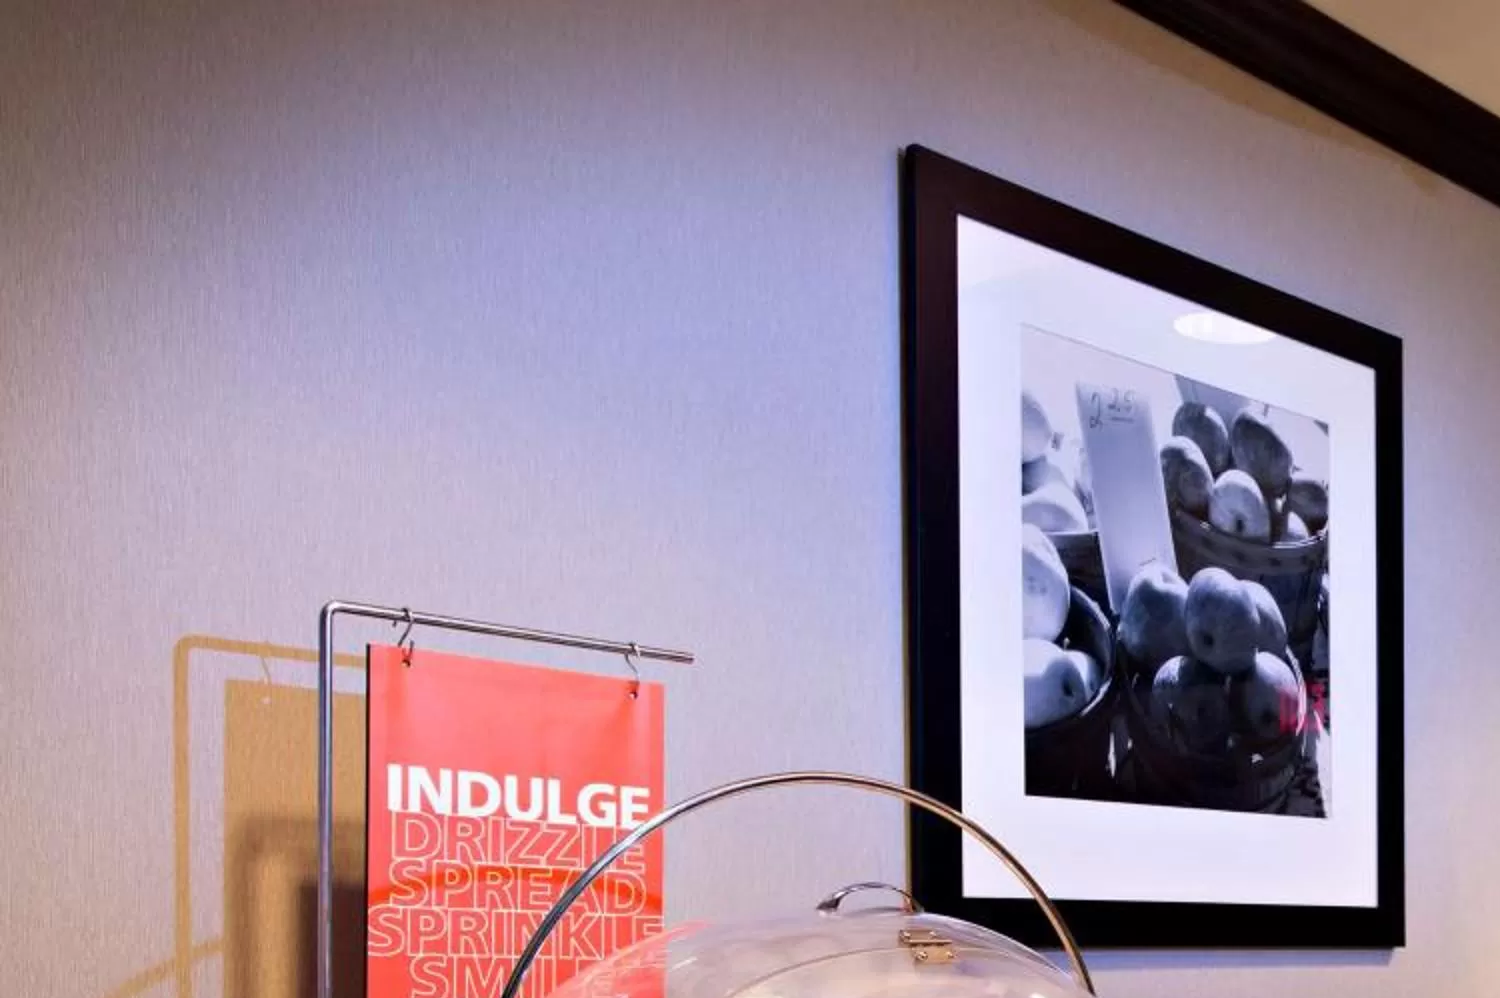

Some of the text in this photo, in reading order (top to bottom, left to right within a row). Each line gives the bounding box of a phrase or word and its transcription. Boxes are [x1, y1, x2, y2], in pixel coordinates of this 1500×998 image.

[386, 763, 650, 830] INDULGE
[390, 811, 646, 875] DRIZZLE
[388, 858, 647, 917] SPREAD
